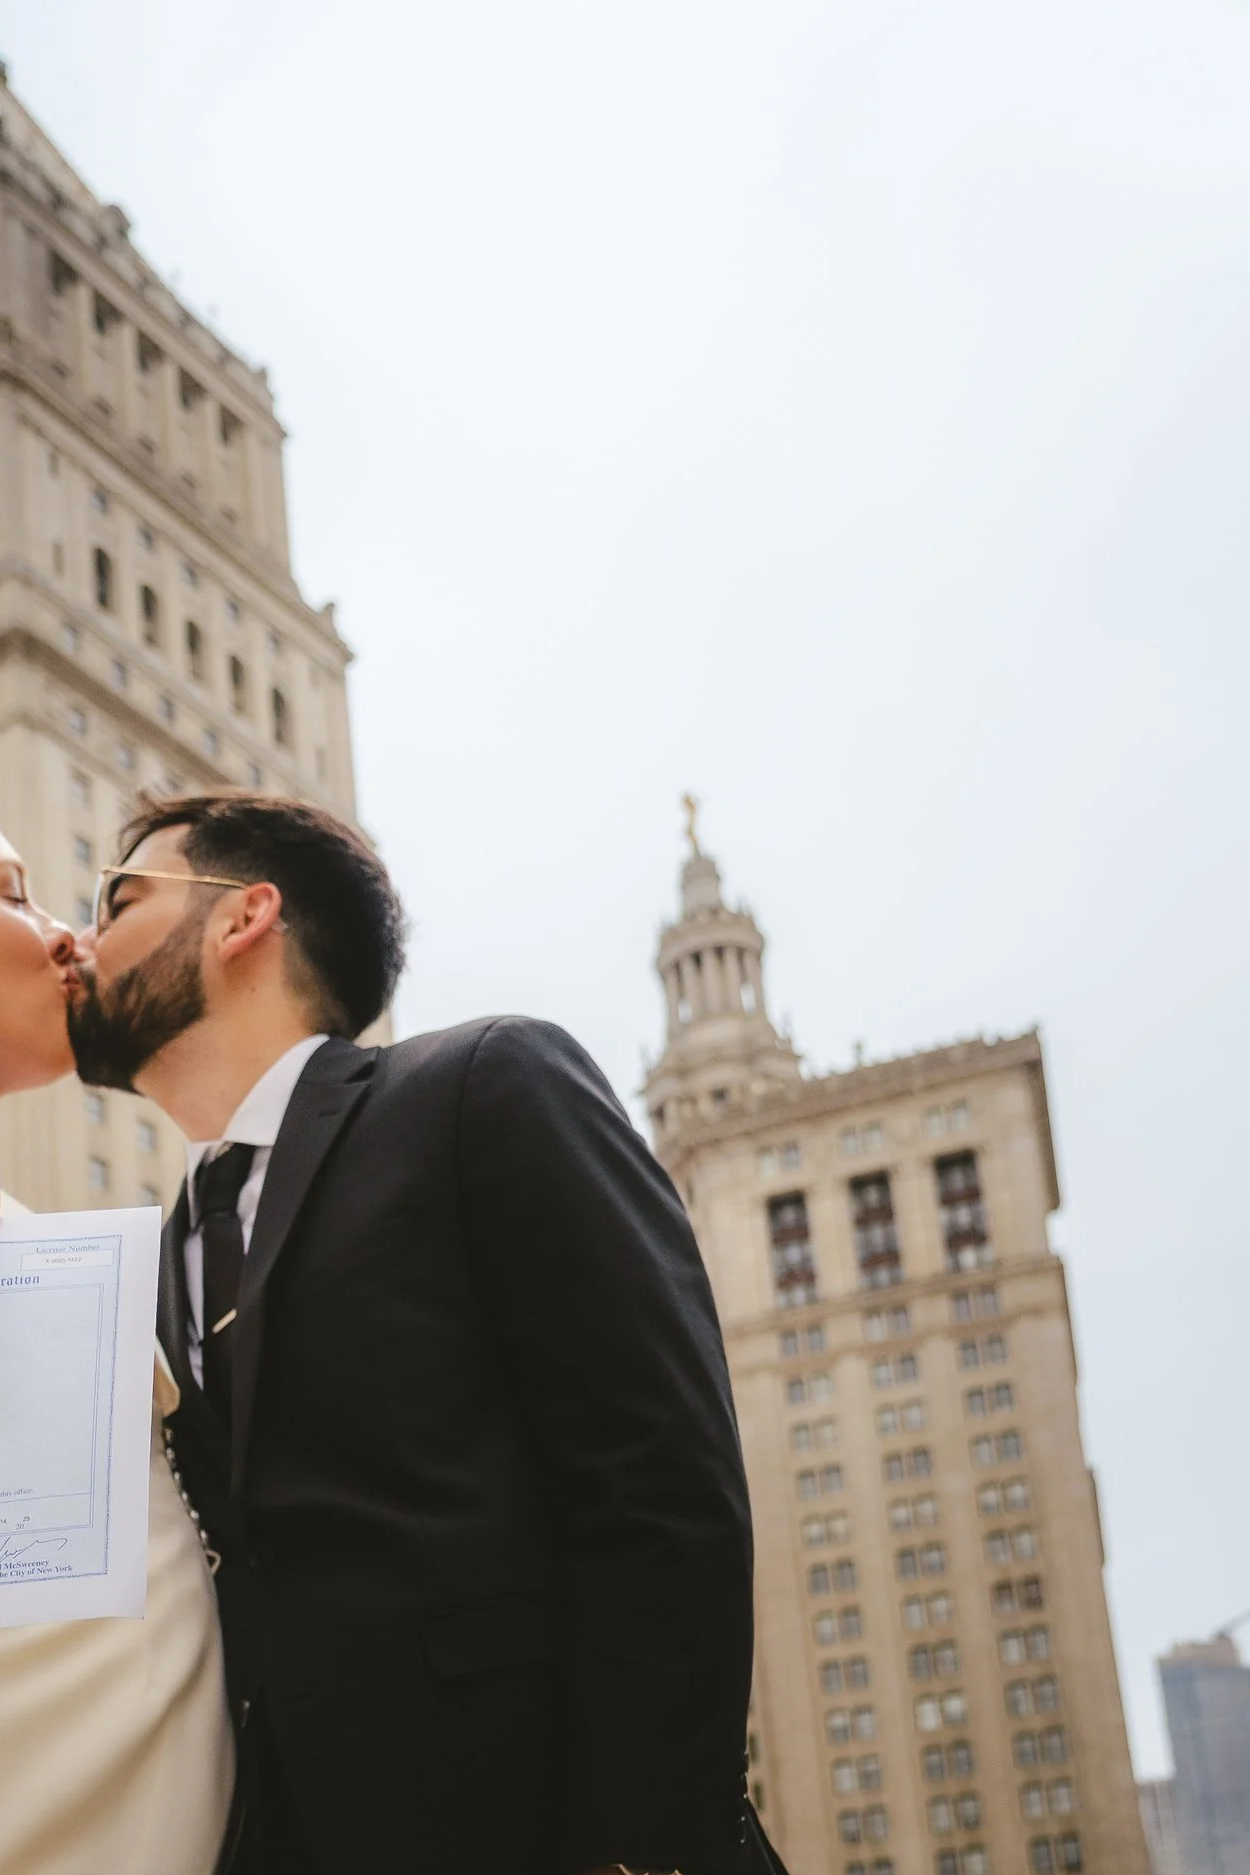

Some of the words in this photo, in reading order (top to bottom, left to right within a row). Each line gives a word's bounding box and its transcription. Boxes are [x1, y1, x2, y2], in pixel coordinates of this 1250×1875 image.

[36, 1247, 66, 1255] License
[69, 1244, 101, 1253] Number
[0, 1490, 13, 1498] this
[3, 1559, 49, 1571] McSweeney
[9, 1569, 25, 1579] City
[26, 1568, 36, 1576] of
[36, 1566, 52, 1575] New
[53, 1563, 73, 1573] York
